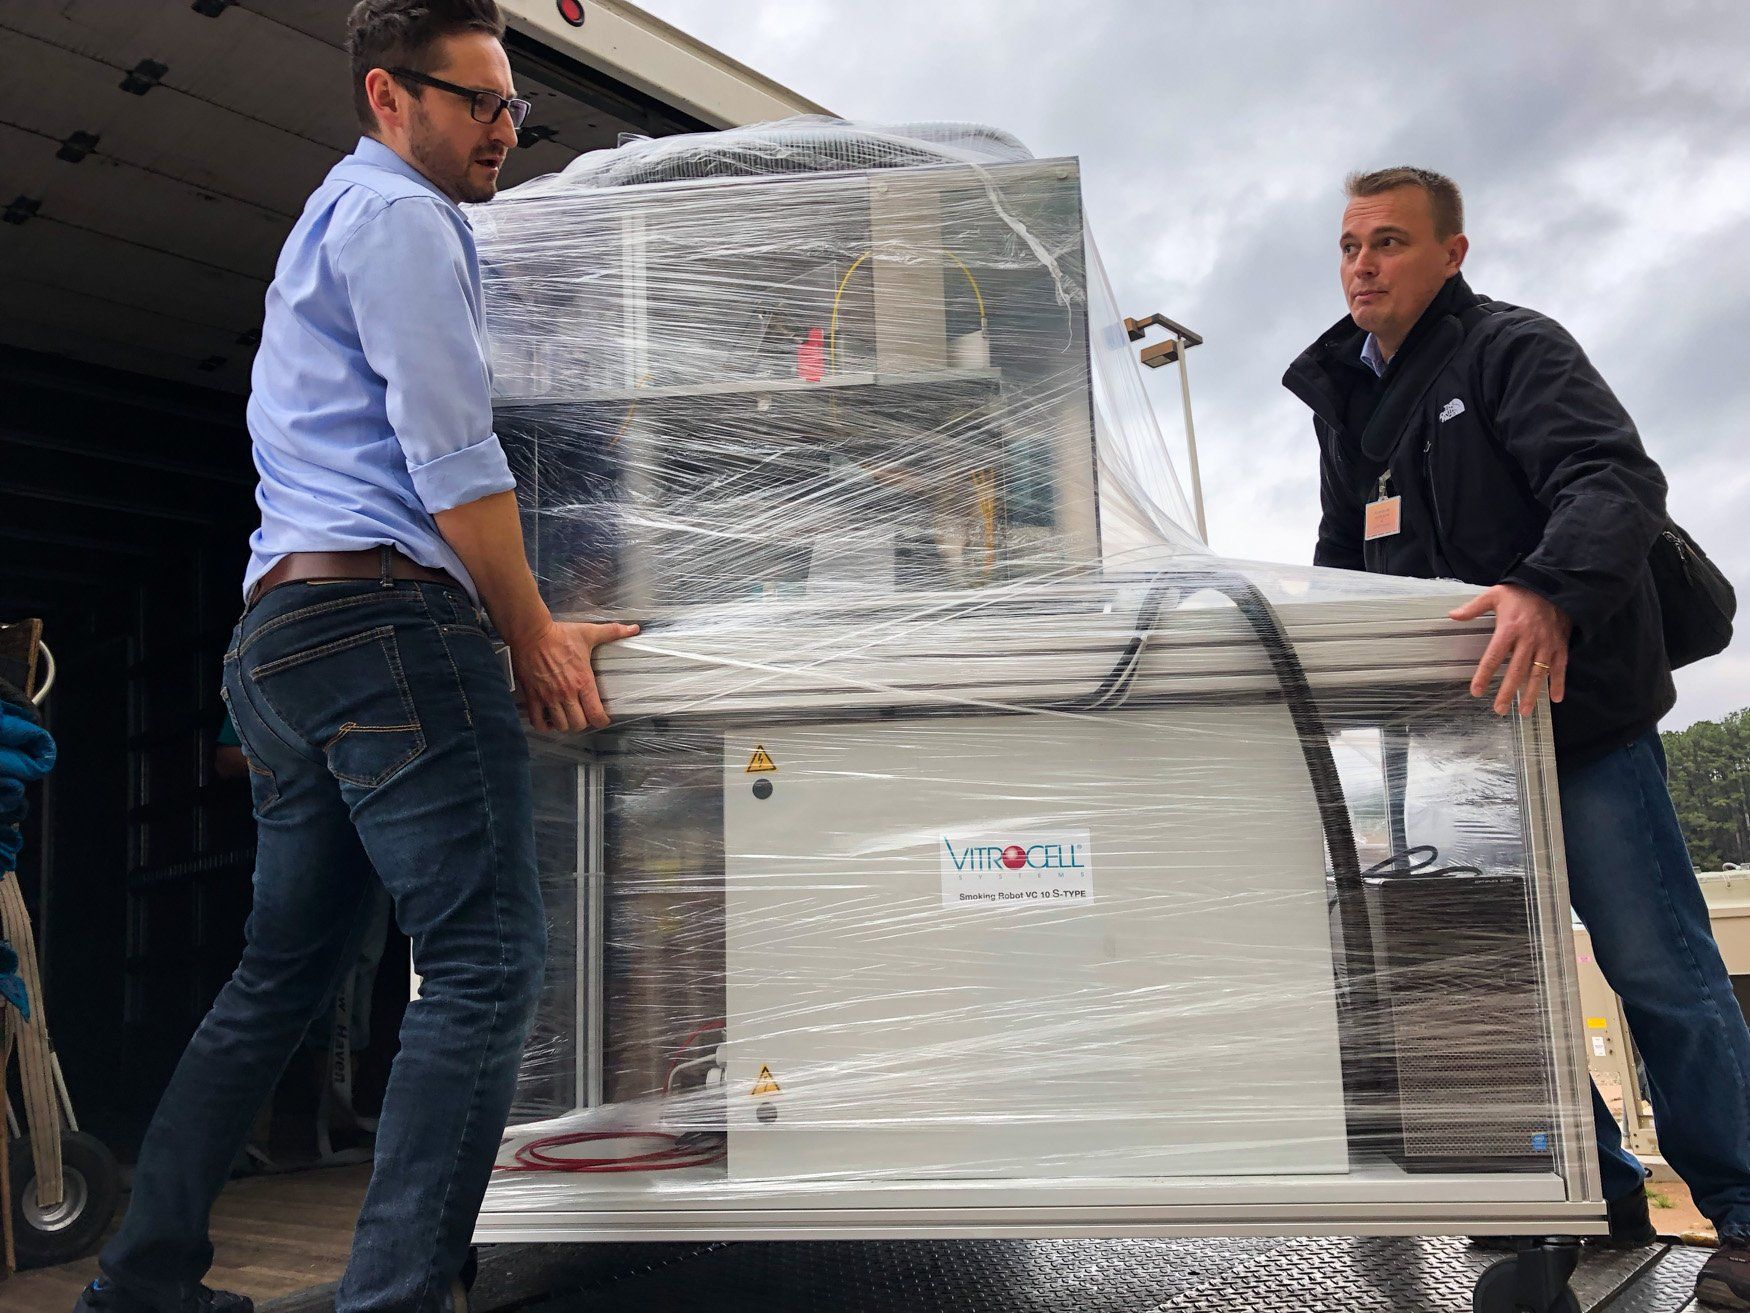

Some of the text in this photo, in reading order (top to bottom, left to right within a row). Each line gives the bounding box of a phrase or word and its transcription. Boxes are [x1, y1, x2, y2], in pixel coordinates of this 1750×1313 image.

[959, 888, 1087, 901] Smoking Robot VC 10 S-TYPE
[333, 1024, 348, 1083] Haven
